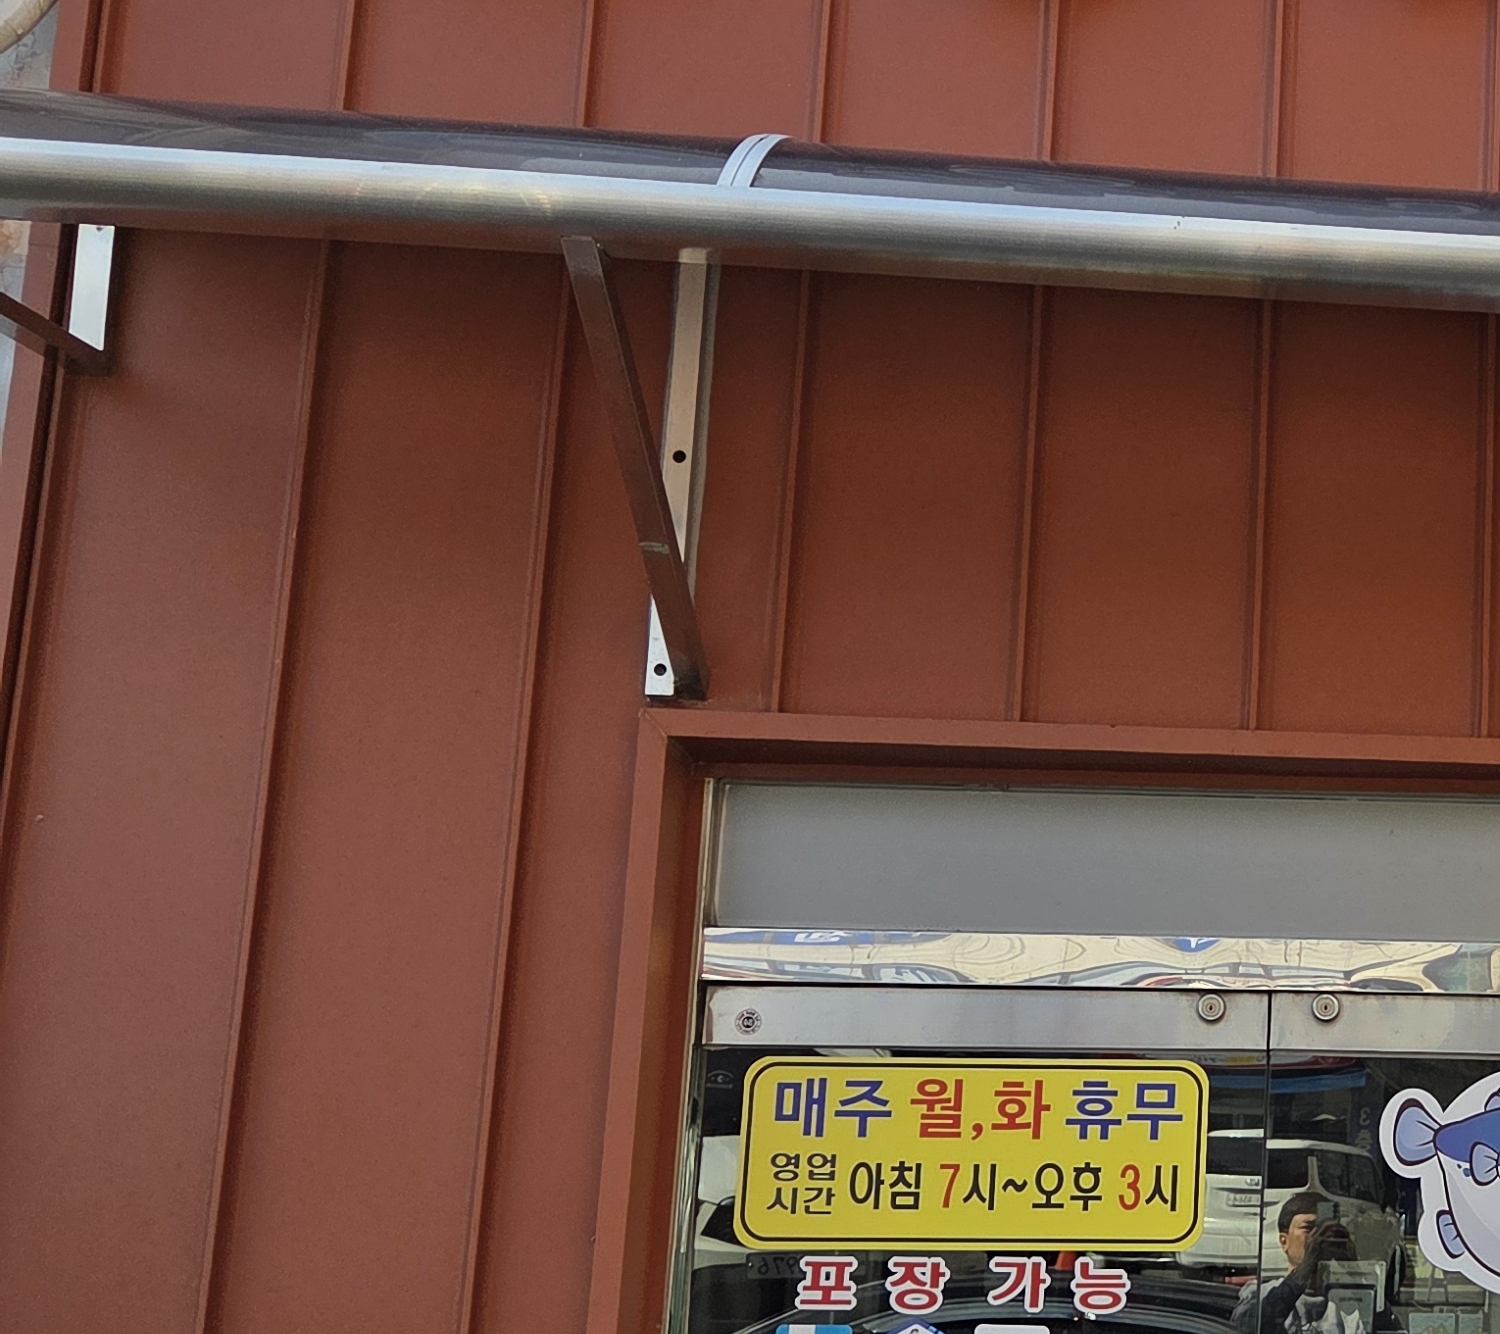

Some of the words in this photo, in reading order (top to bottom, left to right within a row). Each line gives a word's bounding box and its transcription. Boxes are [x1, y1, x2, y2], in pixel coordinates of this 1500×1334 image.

[773, 1077, 893, 1139] 매주
[910, 1078, 1052, 1142] 월,화
[1064, 1079, 1184, 1141] 휴무
[769, 1152, 838, 1182] 영업
[848, 1160, 922, 1211] 아침
[1117, 1163, 1179, 1213] 3시
[766, 1186, 836, 1216] 시간
